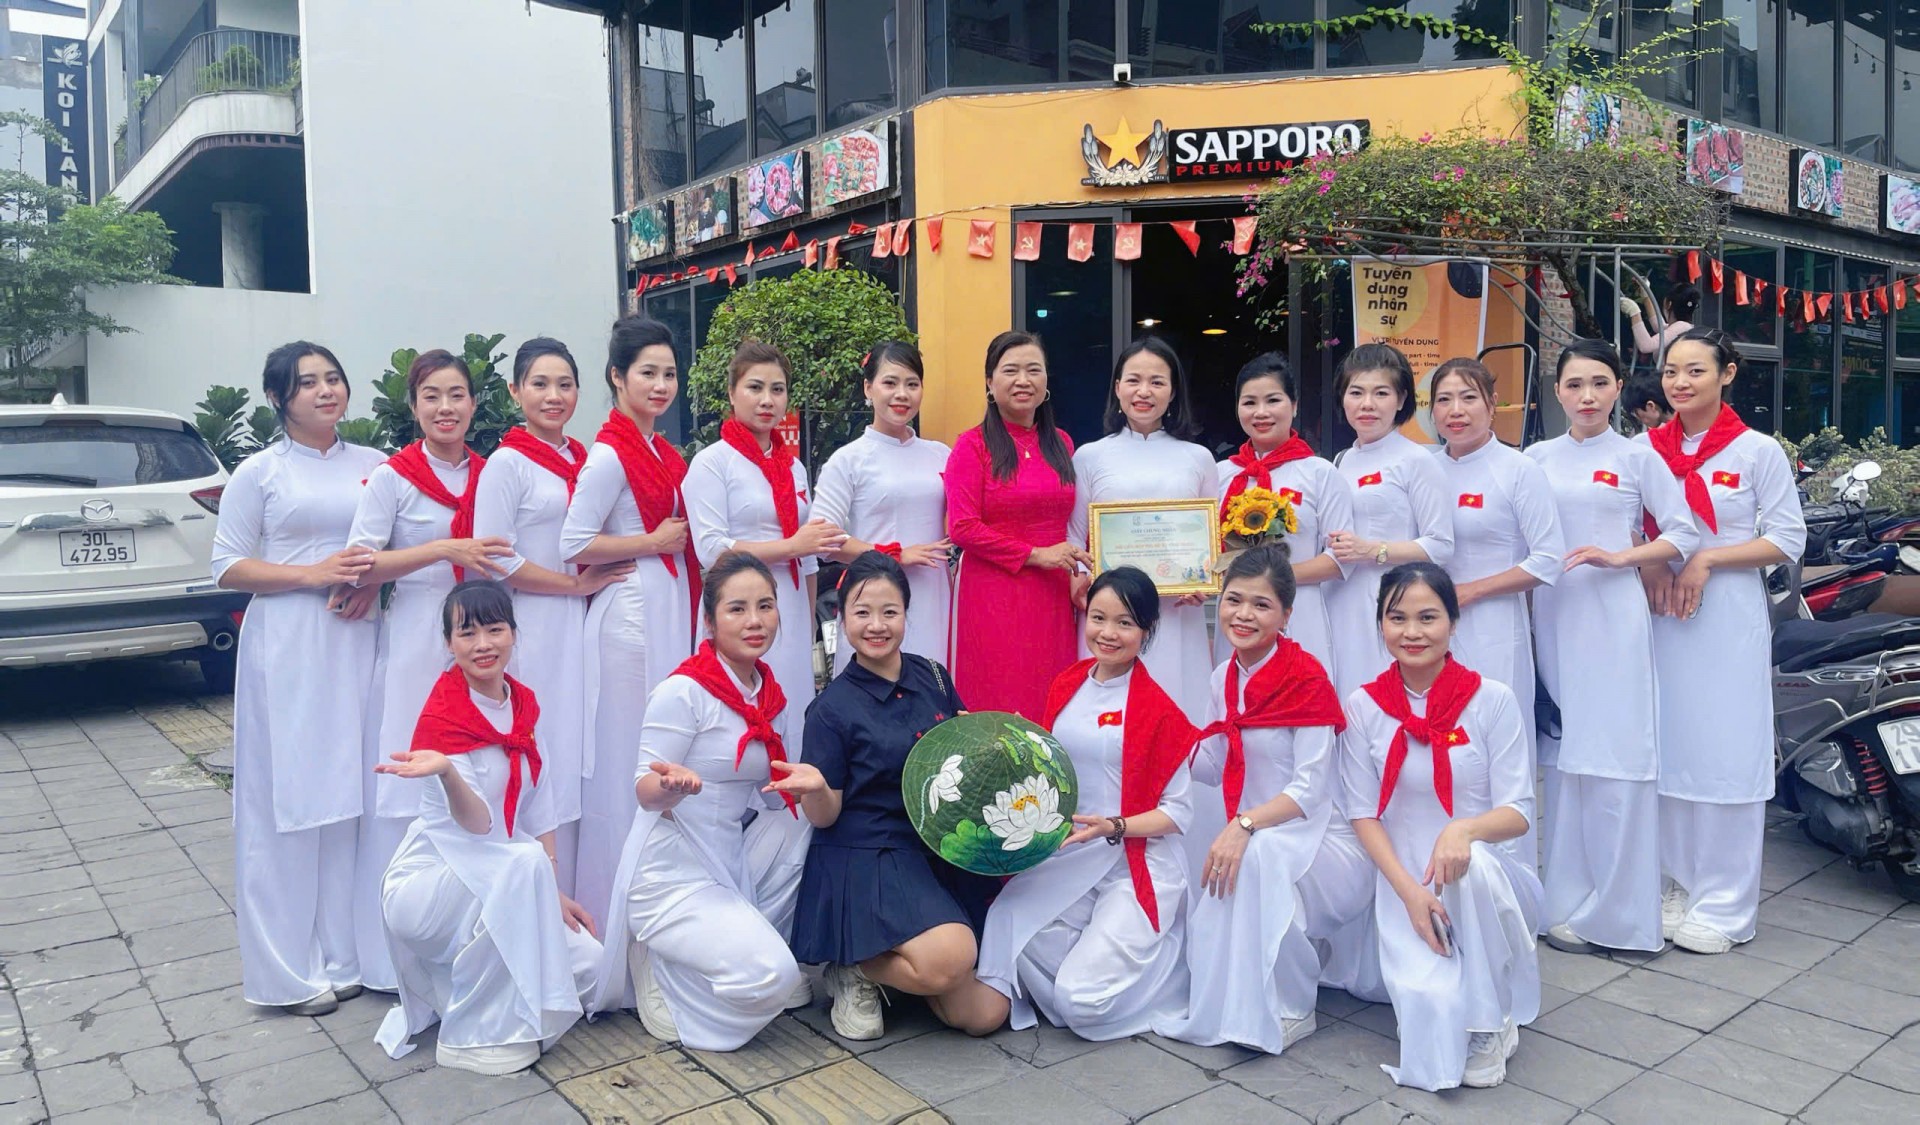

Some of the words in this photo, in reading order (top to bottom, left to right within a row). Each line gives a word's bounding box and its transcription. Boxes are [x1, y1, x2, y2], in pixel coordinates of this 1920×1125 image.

[57, 72, 78, 127] KOI
[1175, 123, 1361, 164] SAPPORO
[1176, 159, 1294, 177] PREMIUM
[82, 532, 114, 547] 30L
[70, 547, 128, 563] 472.95
